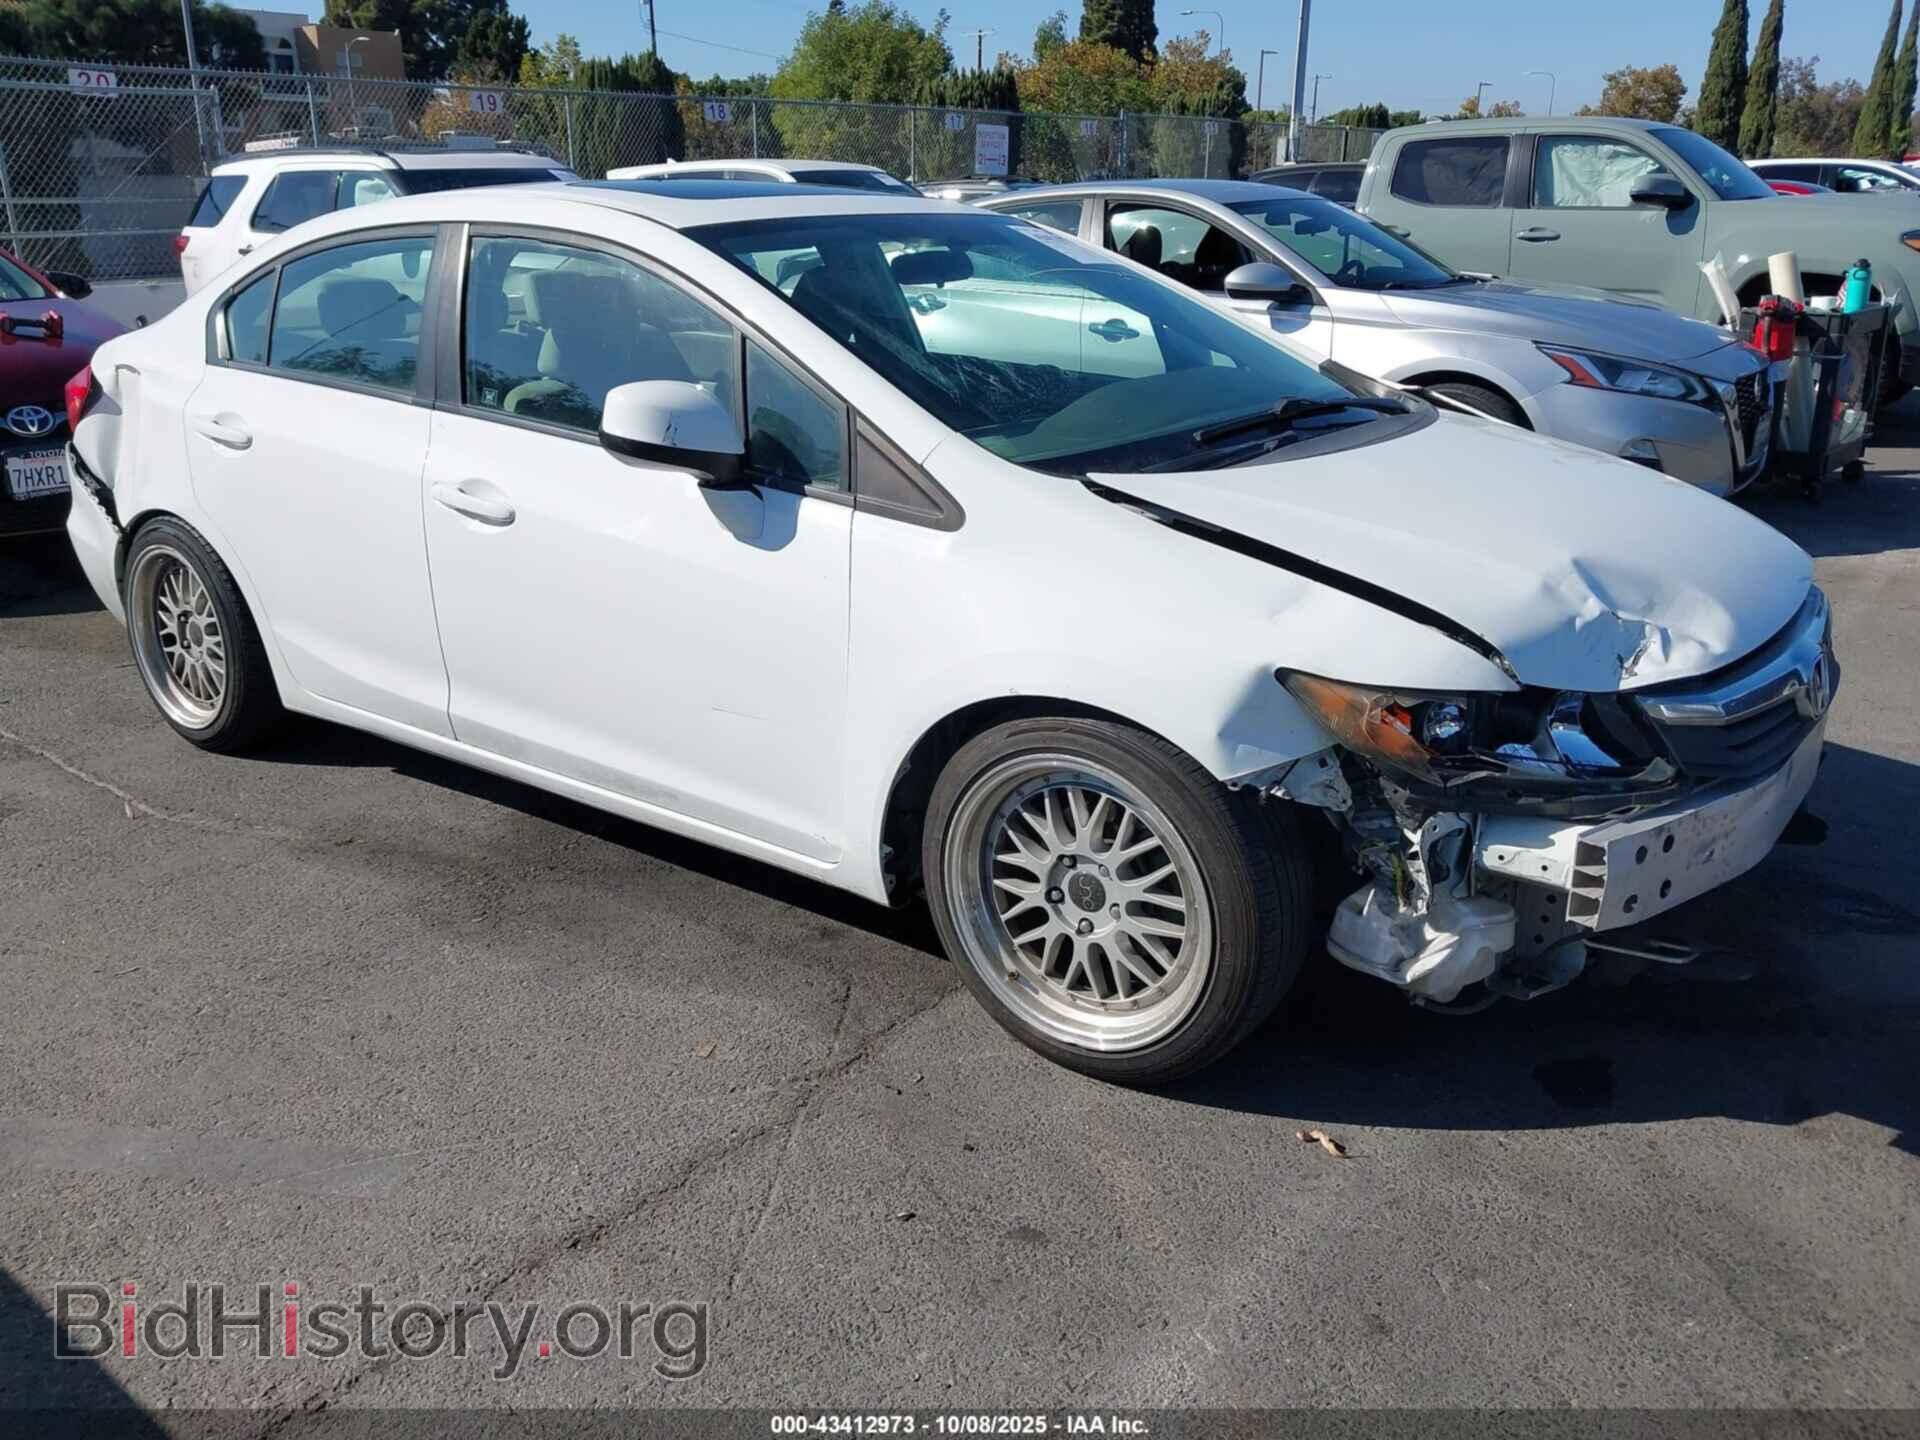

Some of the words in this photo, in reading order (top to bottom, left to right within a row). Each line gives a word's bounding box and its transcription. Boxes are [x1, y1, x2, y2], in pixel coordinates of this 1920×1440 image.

[476, 94, 497, 112] 19
[708, 103, 726, 120] 18
[12, 465, 67, 489] 7HXR1
